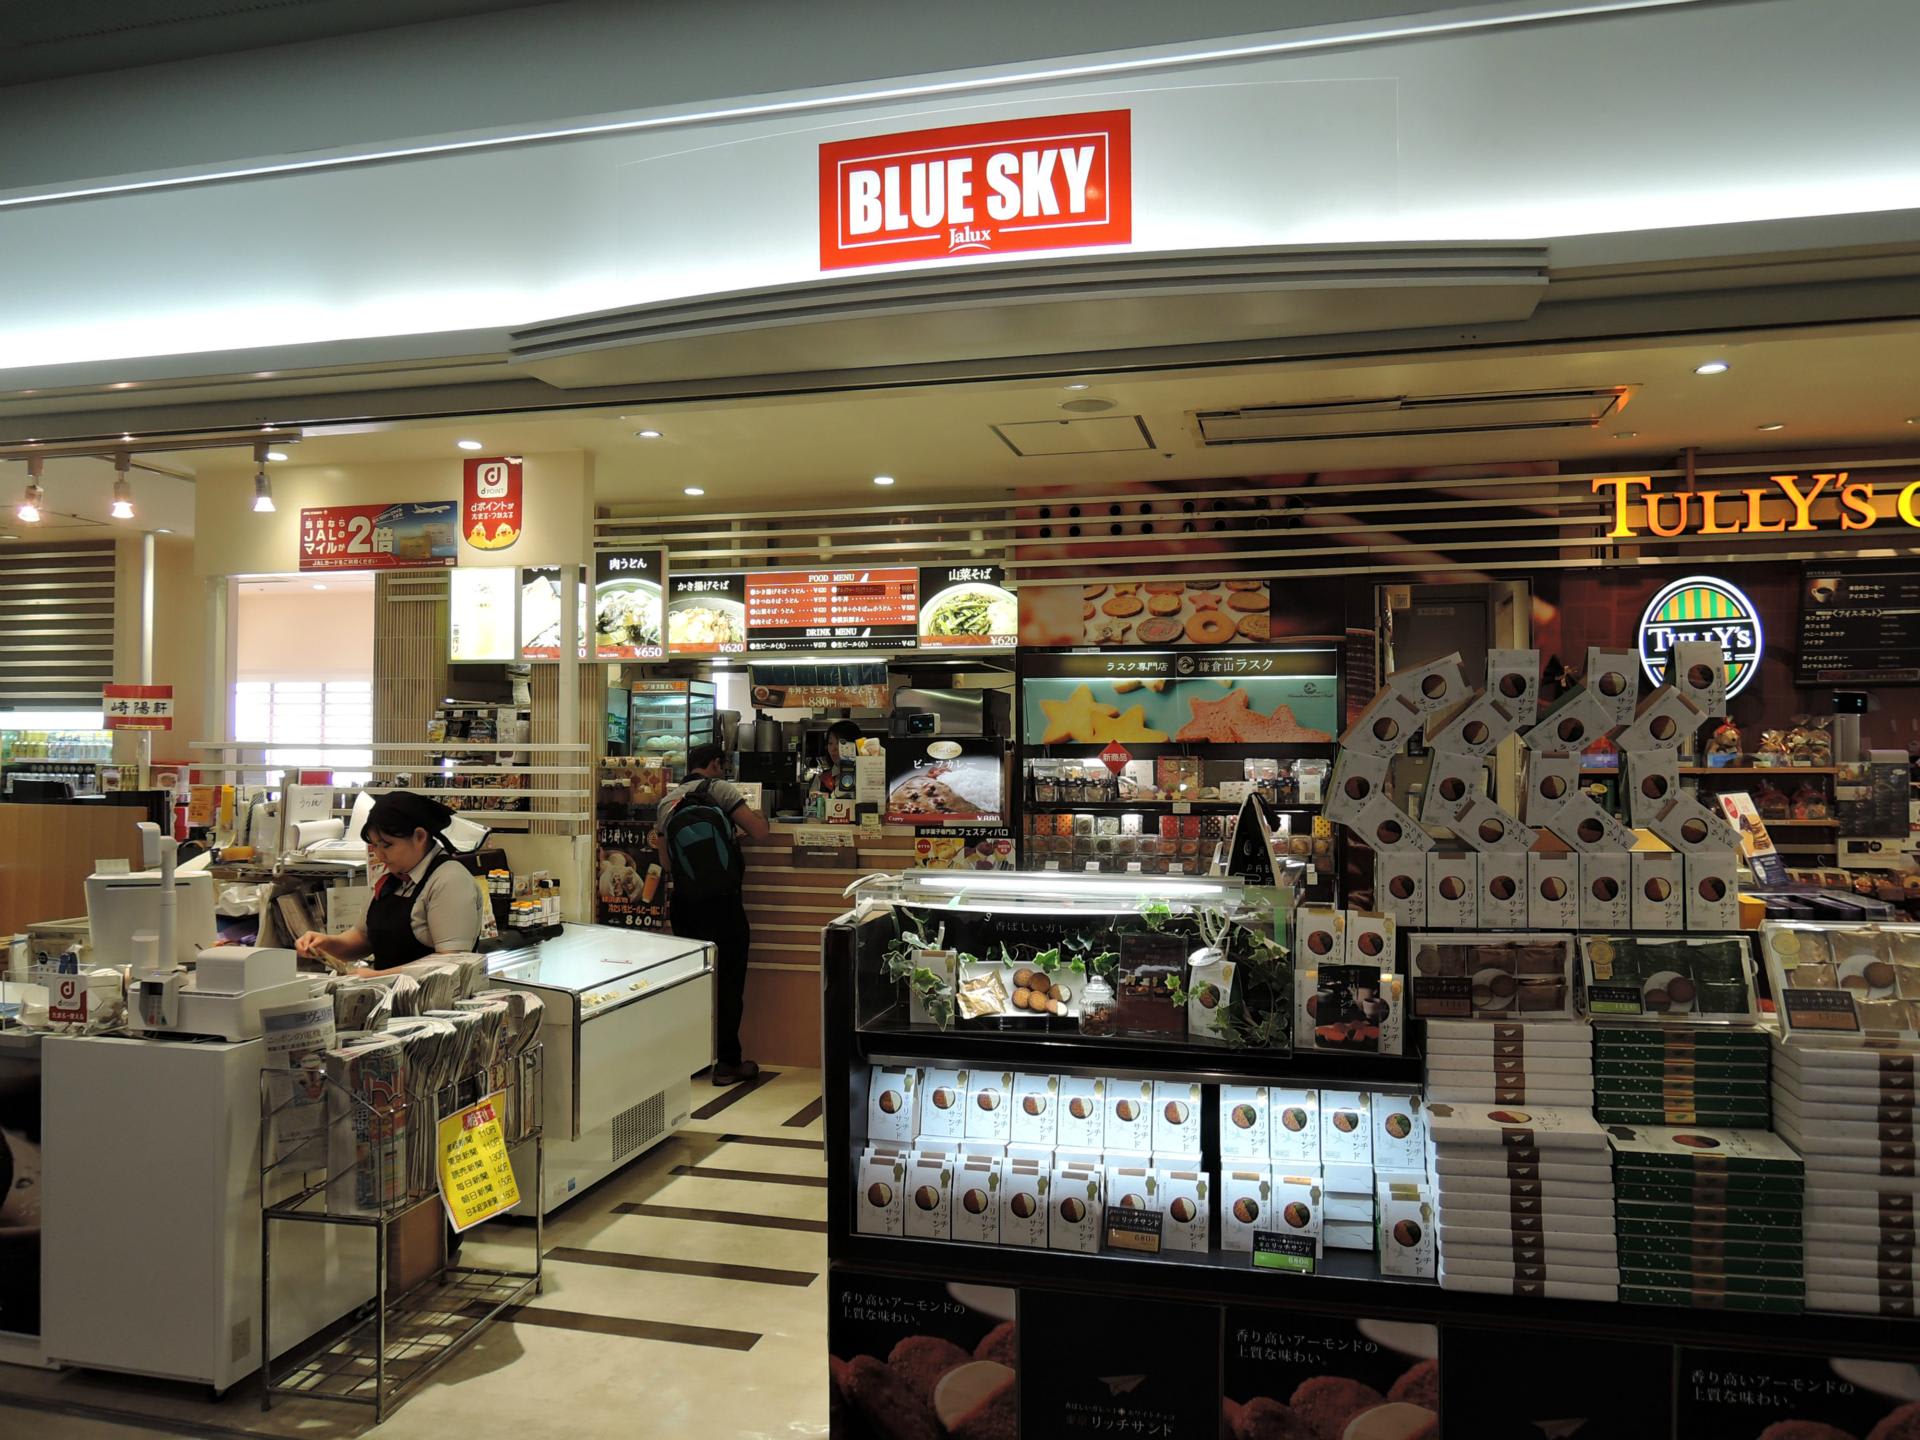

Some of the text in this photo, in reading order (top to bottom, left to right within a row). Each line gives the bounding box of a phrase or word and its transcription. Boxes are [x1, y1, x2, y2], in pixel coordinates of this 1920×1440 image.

[849, 146, 1095, 235] BLUE SKY
[948, 226, 991, 249] Jalux
[471, 501, 514, 512] dポイントが
[1592, 472, 1878, 538] TULLY'S
[609, 558, 647, 570] 肉うどん
[949, 568, 993, 581] 山菜そば
[677, 581, 730, 591] かき揚げそば
[806, 628, 857, 636] DRINK MENU
[990, 636, 1018, 646] ¥620
[635, 647, 662, 657] ¥650
[719, 643, 744, 653] ¥620
[1106, 661, 1169, 672] ラスク専門店
[1199, 658, 1275, 673] 鎌倉山ラスク
[1103, 753, 1128, 762] 新商品
[913, 759, 976, 769] ビーフカレー
[958, 828, 1009, 836] フェスティバロ
[841, 1290, 966, 1315] 香り高いアーモンドの
[1236, 1328, 1379, 1354] 香り高いアーモンドの
[1691, 1368, 1855, 1395] 香り高いアーモンドの
